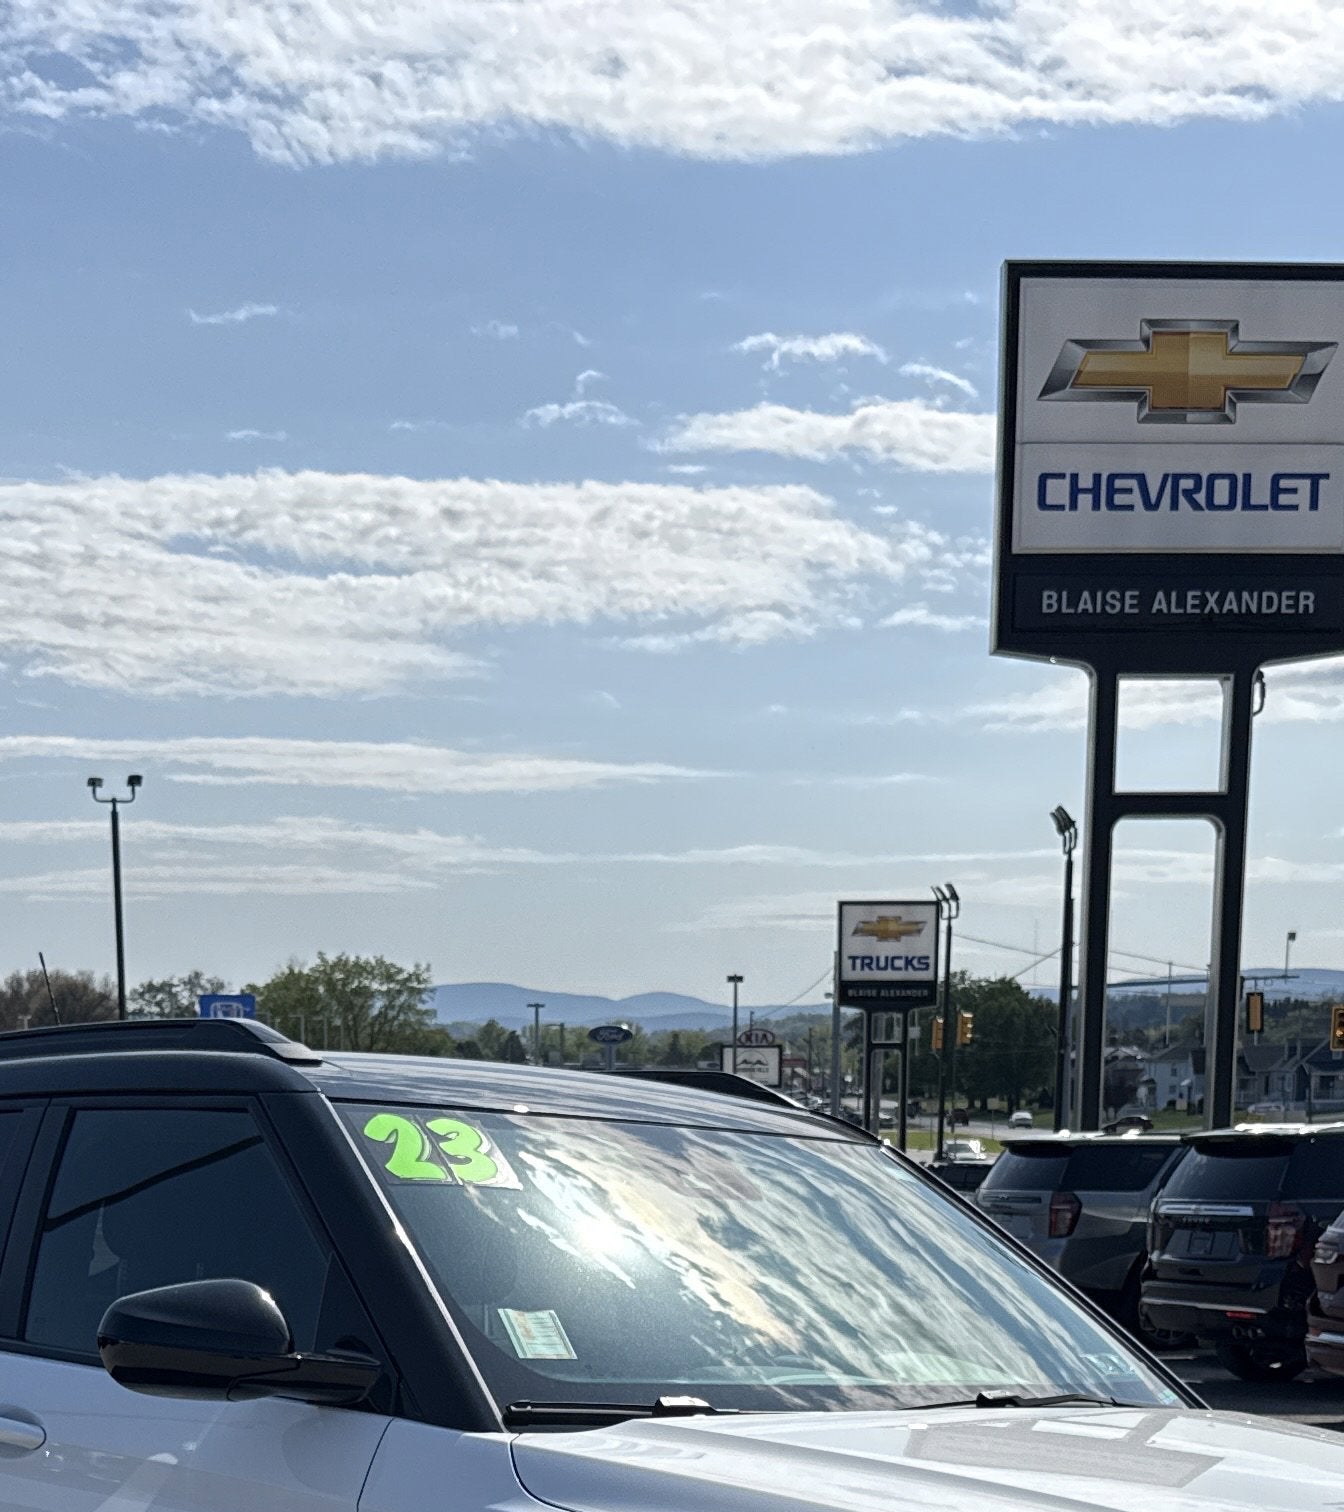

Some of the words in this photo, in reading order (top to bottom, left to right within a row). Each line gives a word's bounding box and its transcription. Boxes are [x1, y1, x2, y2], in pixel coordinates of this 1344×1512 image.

[1037, 472, 1330, 512] CHEVROLET
[1042, 590, 1140, 615] BLAISE
[1151, 590, 1315, 615] ALEXANDER
[848, 955, 930, 971] TRUCKS
[744, 1032, 769, 1044] KIA
[363, 1112, 498, 1184] 23
